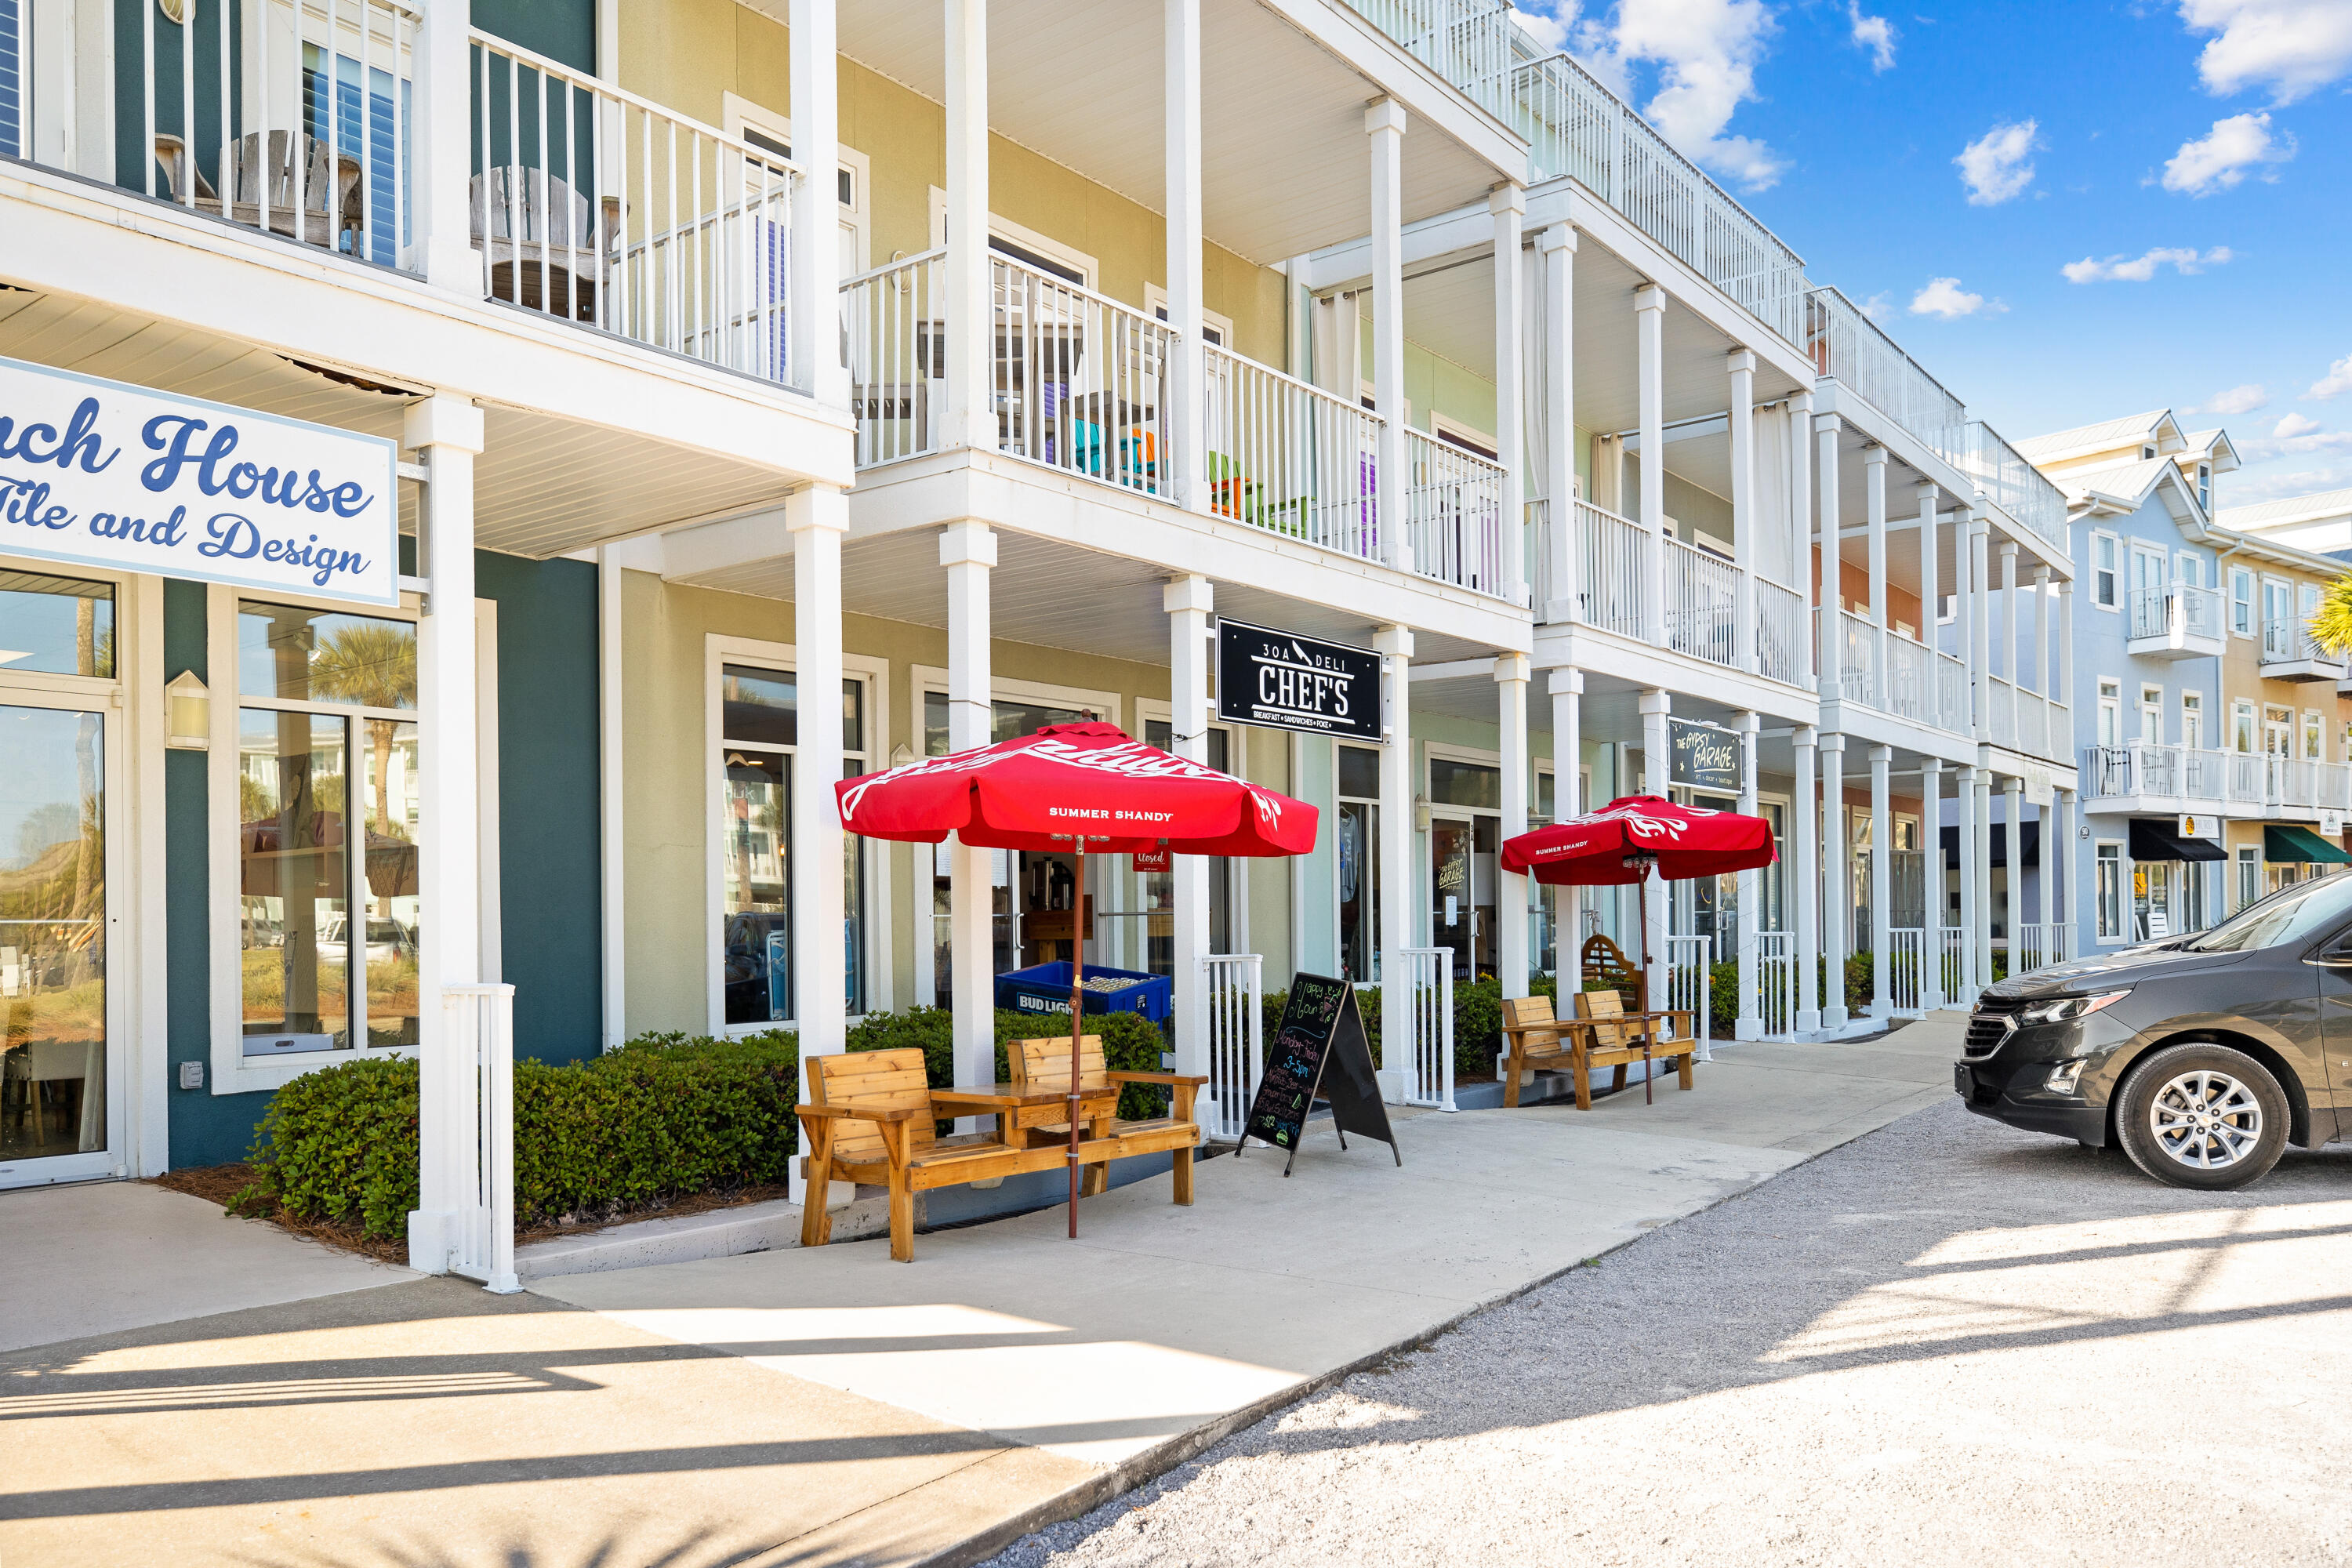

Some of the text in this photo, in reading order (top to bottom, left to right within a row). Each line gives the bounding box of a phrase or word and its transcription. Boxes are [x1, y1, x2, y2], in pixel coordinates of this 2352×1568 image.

[141, 415, 375, 517] House
[89, 504, 187, 547] and
[198, 512, 372, 586] Design
[1316, 654, 1345, 672] DELI
[1259, 666, 1348, 716] CHEF'S
[1253, 710, 1329, 728] BREAKFAST SANDWICHES POKE
[1686, 731, 1710, 750] GYPSY
[1693, 746, 1733, 768] GARAGE
[1049, 807, 1173, 822] SUMMER SHANDY
[1535, 840, 1588, 855] SUMMER SHANDY
[1439, 867, 1464, 886] GARAGE
[1019, 995, 1073, 1014] BUD LIGH
